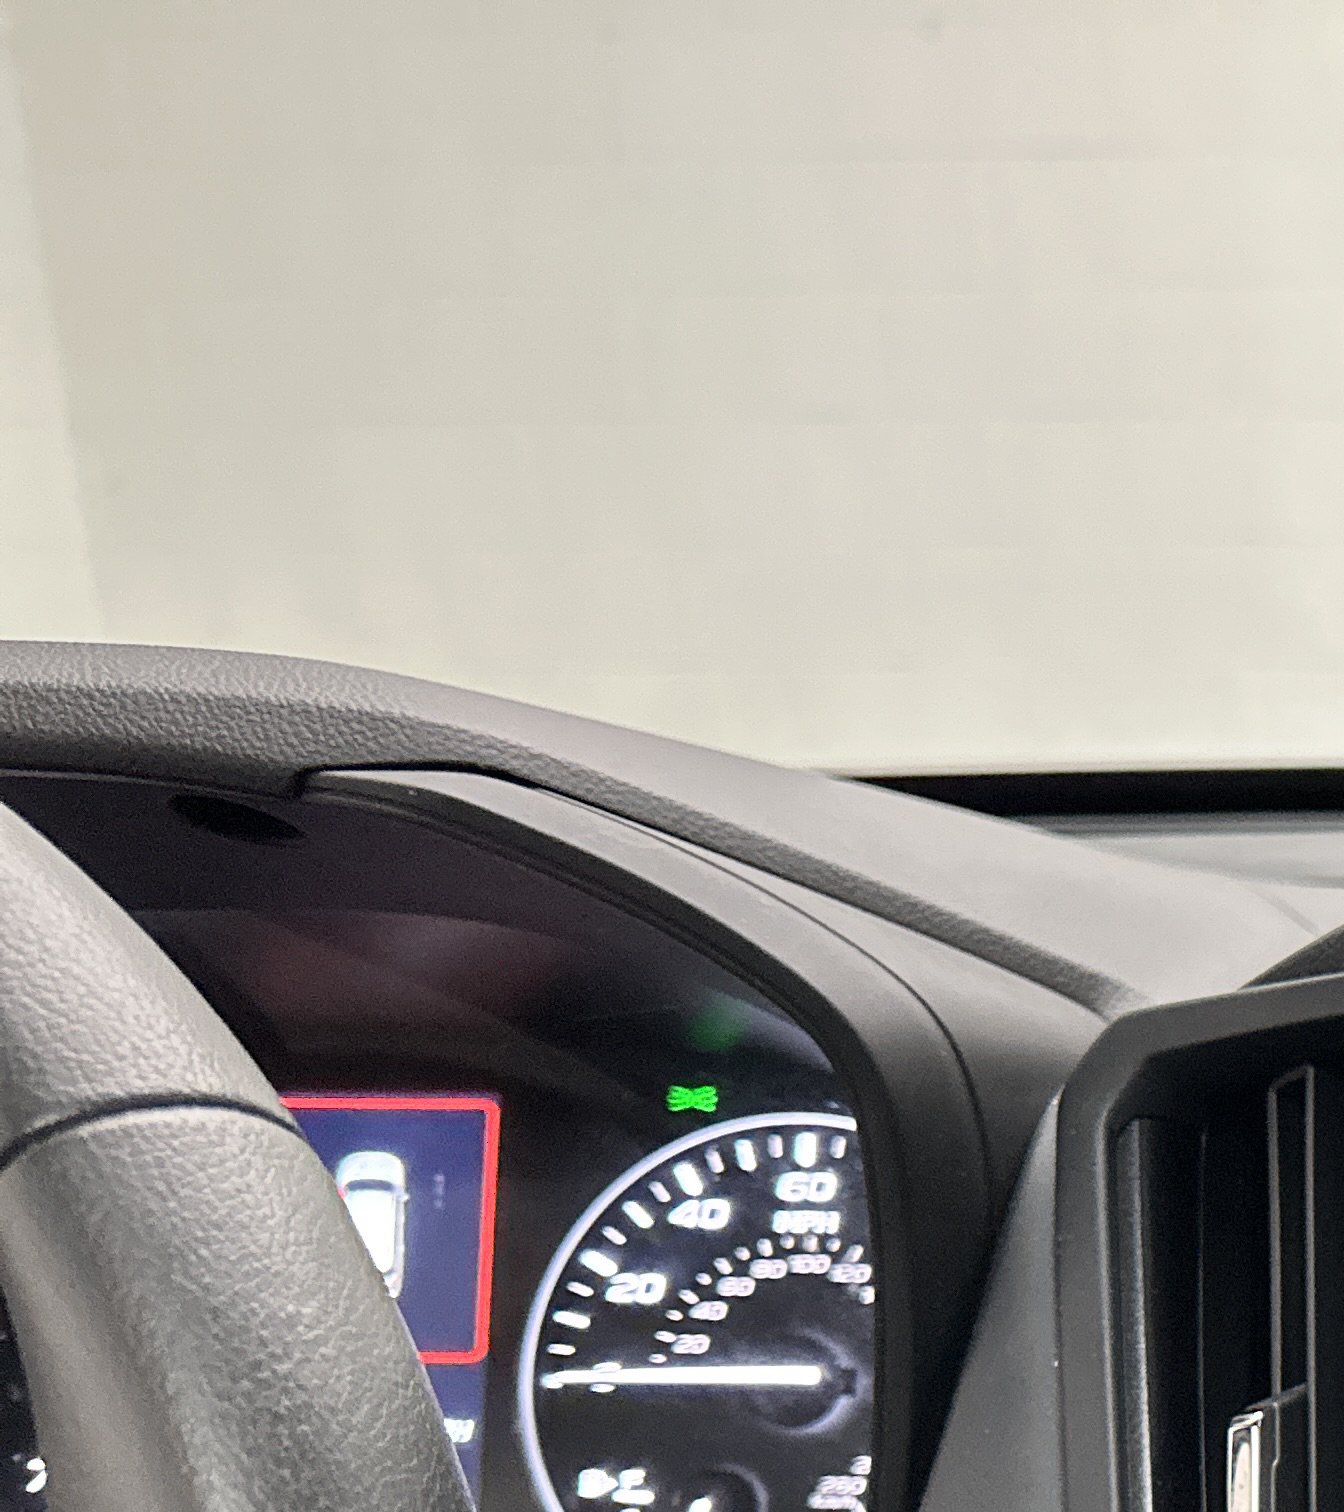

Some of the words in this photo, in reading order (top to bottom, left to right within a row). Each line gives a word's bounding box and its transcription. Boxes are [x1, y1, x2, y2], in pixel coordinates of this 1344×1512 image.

[775, 1171, 838, 1202] 60
[667, 1198, 731, 1230] 40
[604, 1272, 667, 1304] 20
